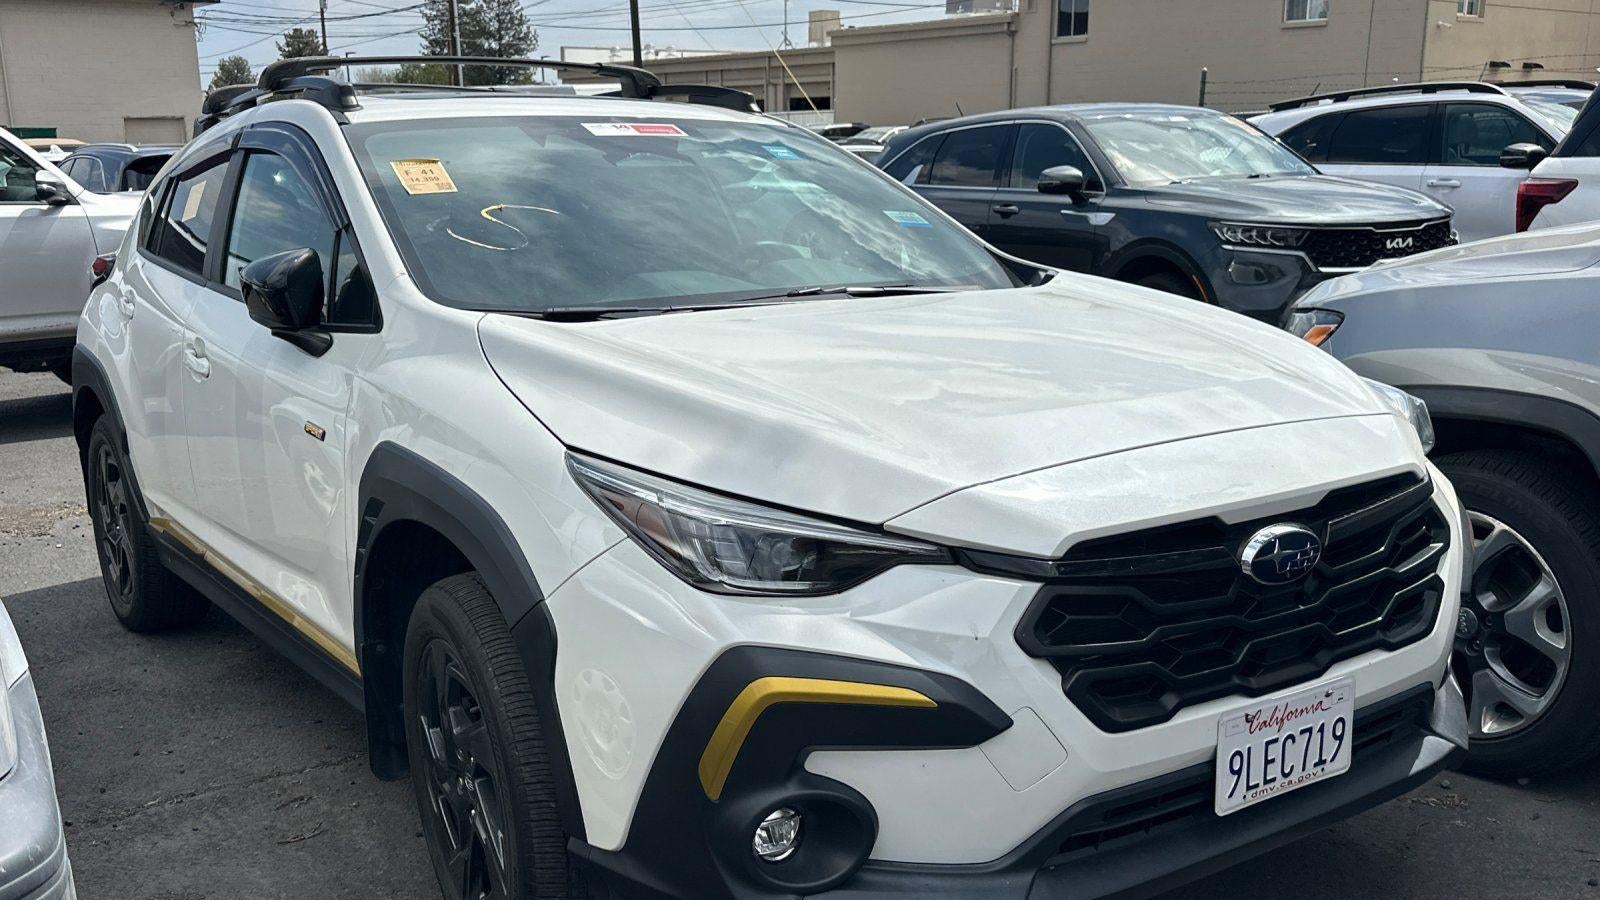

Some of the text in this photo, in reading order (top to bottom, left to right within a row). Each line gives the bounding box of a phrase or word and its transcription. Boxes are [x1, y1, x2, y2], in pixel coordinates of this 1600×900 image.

[1386, 236, 1413, 249] KIA
[1246, 698, 1331, 735] California
[1227, 716, 1346, 799] 9LEC719
[1251, 769, 1319, 799] dmv.ca.gov
